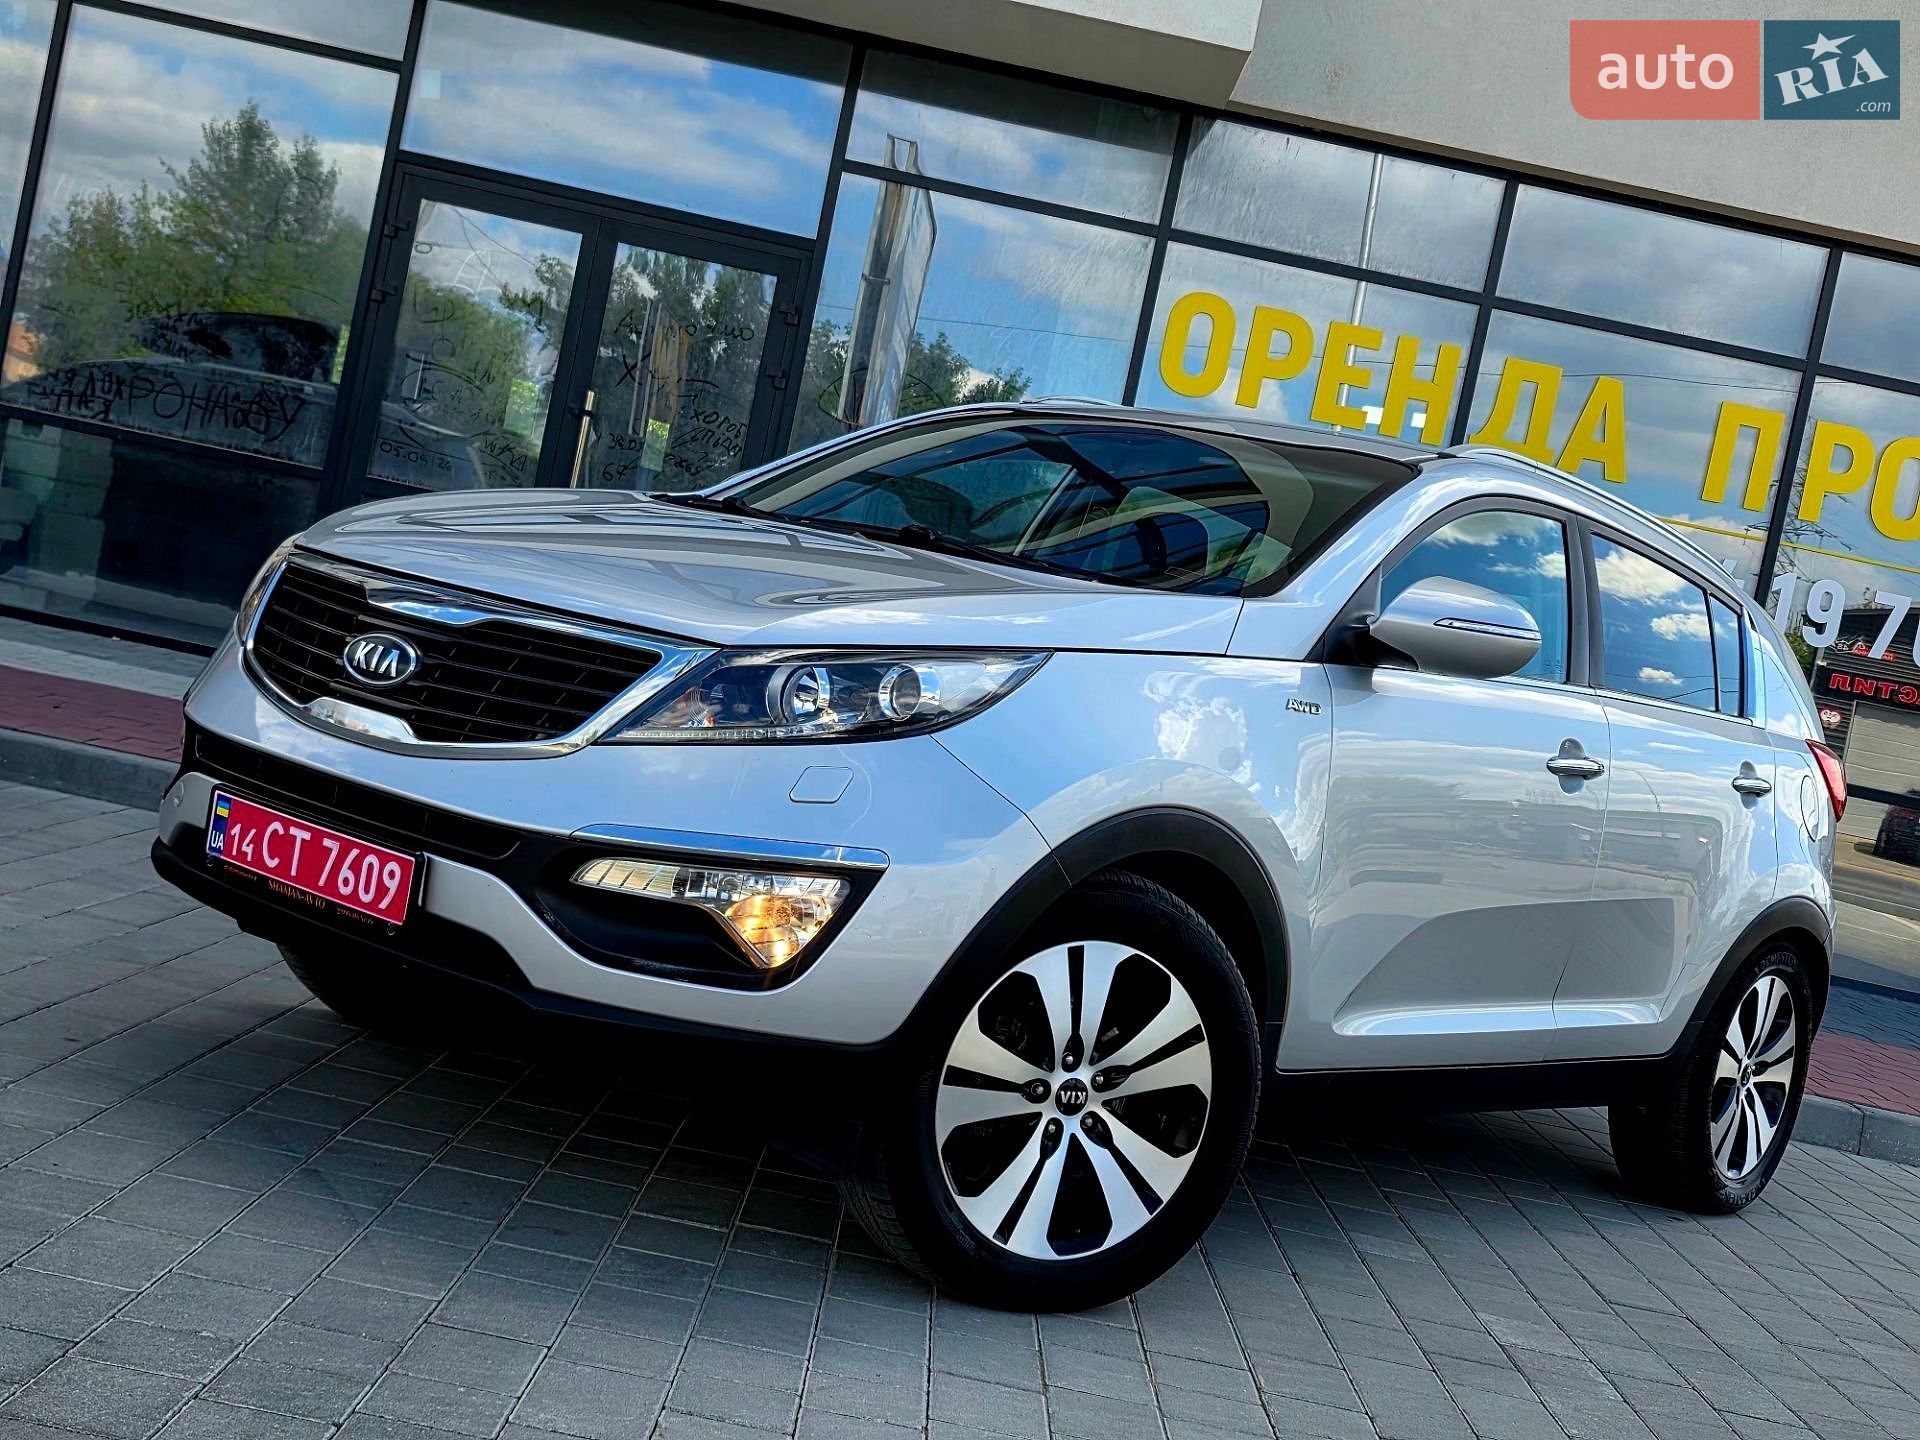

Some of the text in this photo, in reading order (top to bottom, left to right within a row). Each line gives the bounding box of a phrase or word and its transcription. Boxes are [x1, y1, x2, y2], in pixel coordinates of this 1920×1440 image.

[1159, 291, 1627, 484] ОРЕНДА
[352, 641, 400, 677] KIA
[1285, 698, 1322, 716] AWD
[211, 830, 225, 851] UA
[317, 837, 401, 910] 7609
[1060, 1090, 1087, 1105] KIA
